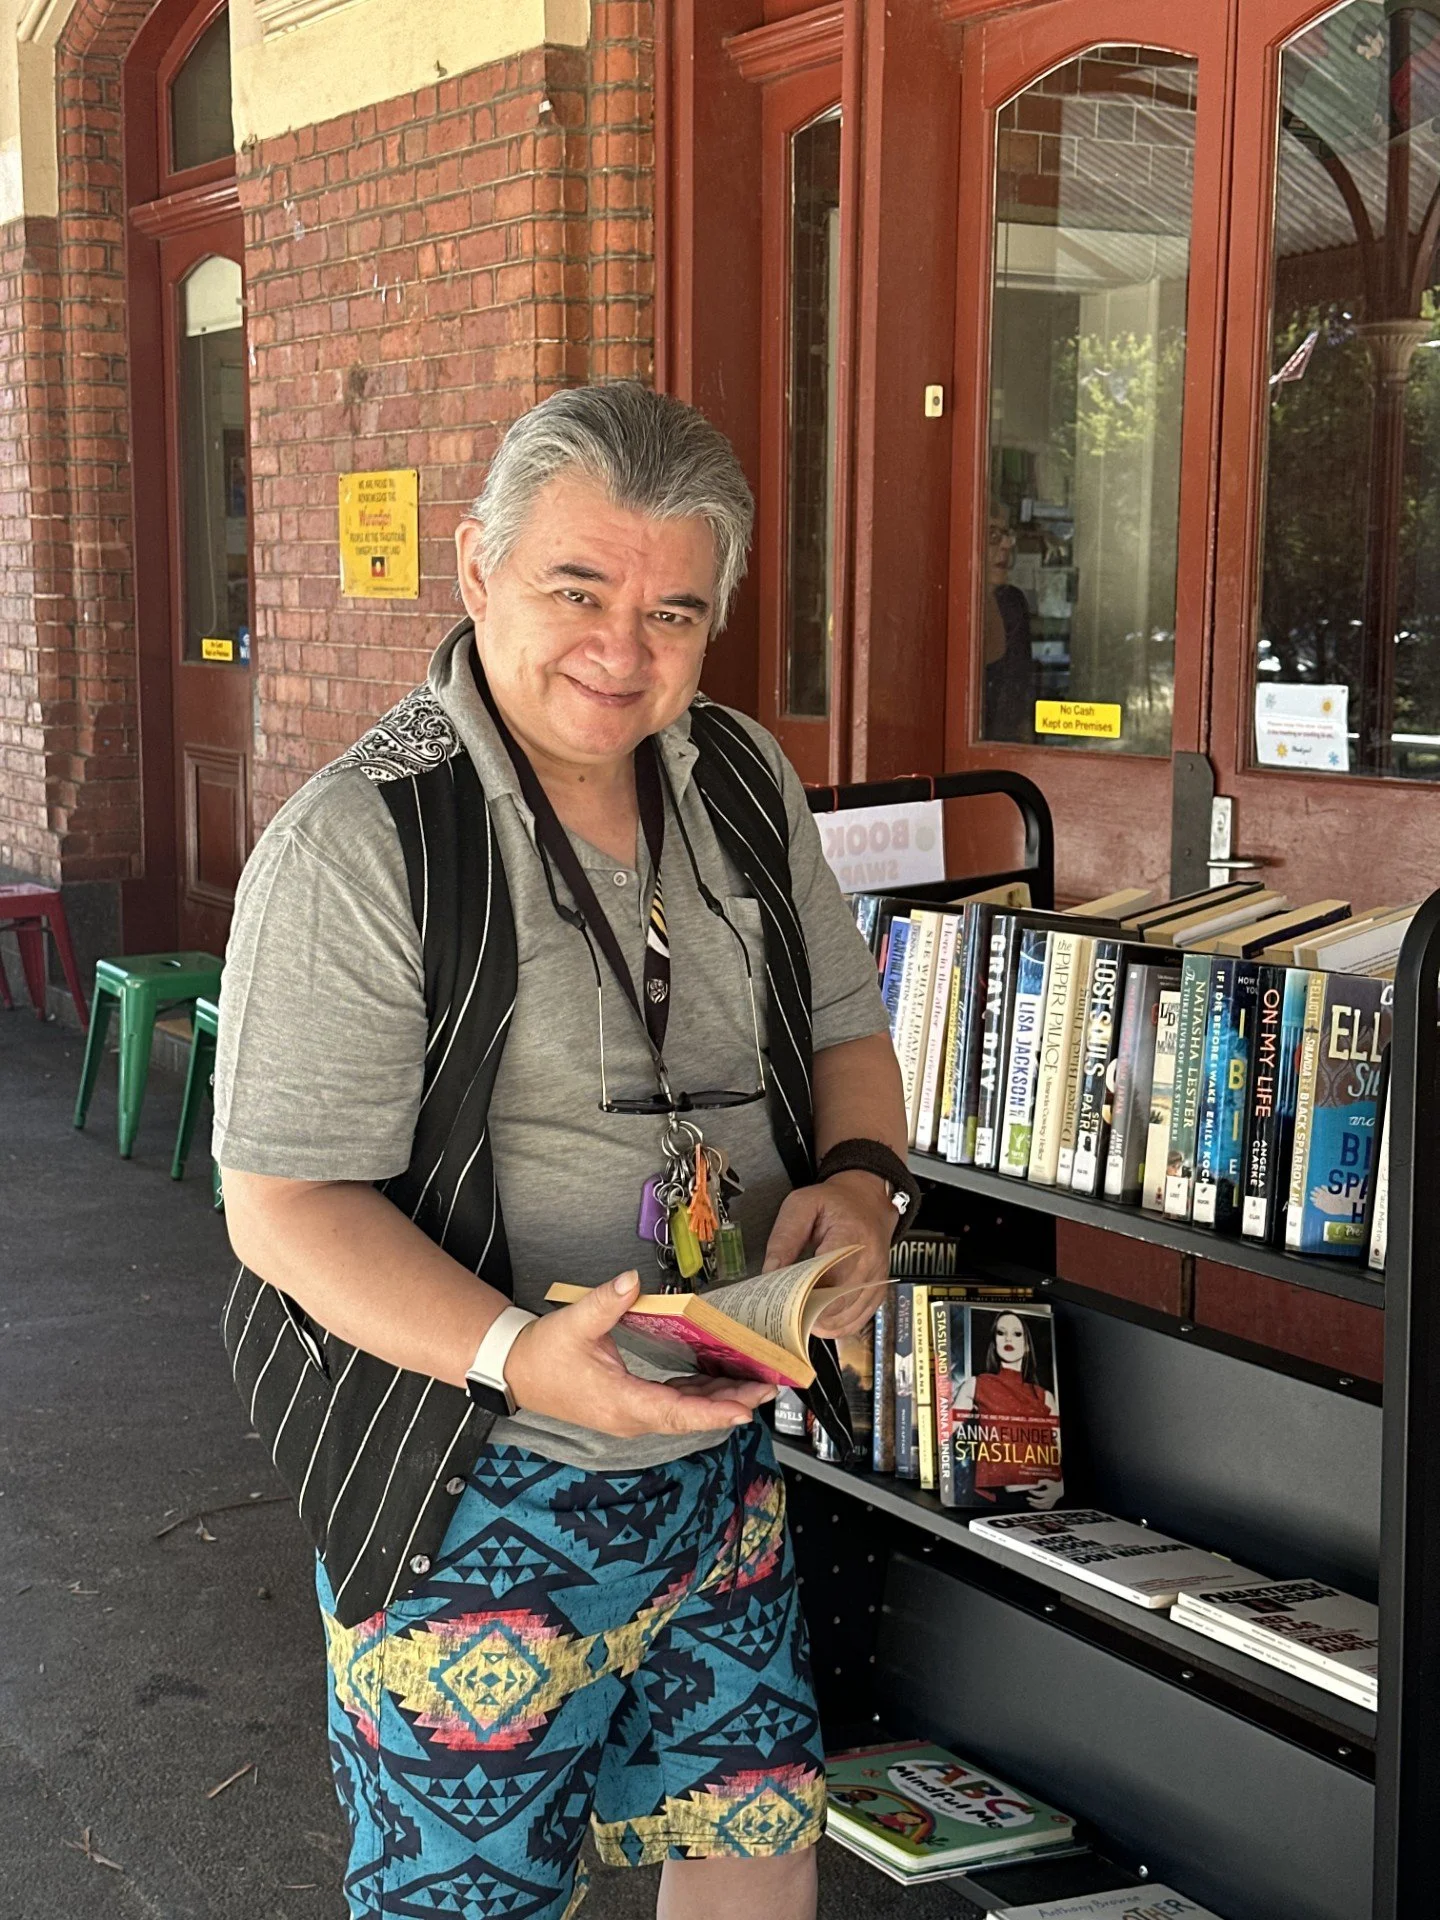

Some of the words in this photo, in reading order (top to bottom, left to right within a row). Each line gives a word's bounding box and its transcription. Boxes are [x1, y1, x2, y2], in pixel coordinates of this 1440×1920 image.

[1042, 718, 1061, 730] Kept
[1063, 721, 1073, 729] on
[1075, 720, 1113, 732] Premises
[1060, 704, 1072, 715] No
[1073, 705, 1095, 716] Cash
[908, 924, 920, 959] JENNA
[923, 931, 934, 959] SEE
[942, 922, 953, 954] Here
[1057, 939, 1073, 952] the
[939, 958, 948, 969] in
[986, 934, 1007, 1015] GRAY
[1051, 952, 1071, 1006] PAPER
[1184, 965, 1196, 986] The
[1216, 970, 1225, 983] IF
[1238, 976, 1255, 985] HOW
[902, 962, 914, 1001] MARTIN
[916, 964, 930, 1007] WHAT
[937, 973, 947, 994] the
[1090, 958, 1119, 1009] LOST
[932, 997, 943, 1028] after
[1018, 1002, 1036, 1033] LISA
[1180, 988, 1191, 1019] THREE
[1212, 991, 1224, 1012] DIE
[1262, 988, 1280, 1024] ON
[1308, 985, 1321, 1022] ELLIOTT
[1178, 1022, 1188, 1049] LIVES
[1189, 981, 1206, 1060] NATASHA
[908, 1025, 921, 1064] HAVE
[1044, 1012, 1065, 1074] PALACE
[1084, 1009, 1113, 1077] SOULS
[1210, 1015, 1222, 1061] BEFORE
[1259, 1033, 1278, 1068] MY
[980, 1032, 999, 1091] DAY
[1009, 1040, 1032, 1107] JACKSON
[1176, 1051, 1185, 1065] OF
[1175, 1067, 1184, 1092] ALIX
[1206, 1069, 1218, 1104] WAKE
[1080, 1093, 1094, 1132] PATR
[1174, 1093, 1182, 1106] ST
[1183, 1067, 1199, 1129] LESTER
[1255, 1076, 1274, 1118] LIFE
[1296, 1092, 1310, 1130] BLACK
[1171, 1107, 1181, 1141] PIERRE
[1204, 1110, 1215, 1148] EMILY
[1250, 1140, 1260, 1186] CLARKE
[1258, 1139, 1268, 1188] ANGELA
[1290, 1132, 1306, 1190] SPARROW
[1376, 1210, 1386, 1243] Martin
[916, 1312, 924, 1354] LOVING
[935, 1310, 948, 1374] STASILAND
[939, 1396, 950, 1430] ANNA
[956, 1424, 1000, 1442] ANNA
[1001, 1426, 1058, 1446] FUNDER
[940, 1431, 950, 1479] FUNDER
[955, 1441, 1061, 1466] STASILAND
[987, 1510, 1101, 1529] QUARTERLY
[1029, 1534, 1082, 1547] HIGH
[1070, 1551, 1118, 1565] DON
[1117, 1543, 1193, 1558] WATSON
[1199, 1582, 1323, 1604] QUARTERLY
[1272, 1589, 1341, 1604] ESSAY
[1249, 1614, 1294, 1625] RED
[1268, 1620, 1323, 1633] FLAG
[1297, 1633, 1364, 1647] PETER
[1311, 1639, 1378, 1654] HARTC
[886, 1765, 973, 1810] Mindful
[965, 1810, 1003, 1830] Me
[912, 1762, 1040, 1821] ABC
[1038, 1902, 1094, 1919] Anthony
[1091, 1895, 1141, 1909] Browne
